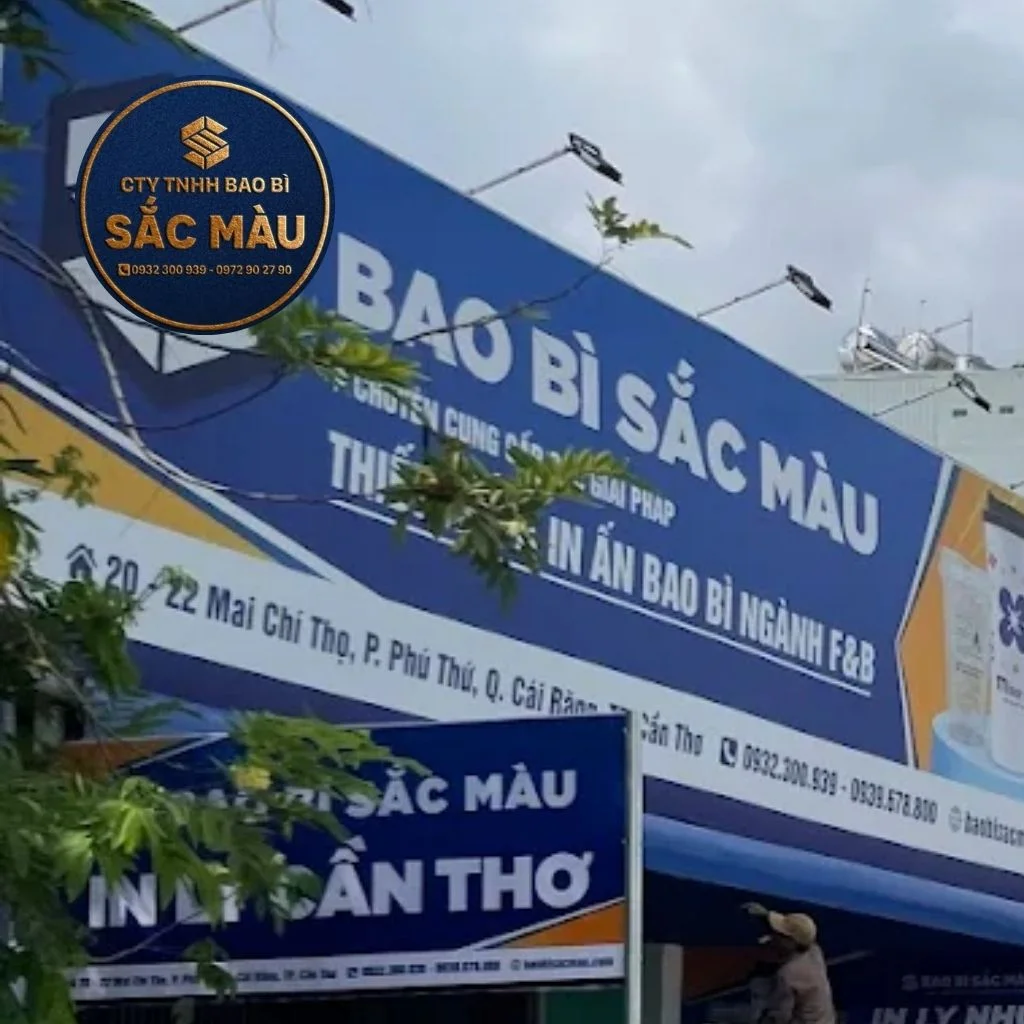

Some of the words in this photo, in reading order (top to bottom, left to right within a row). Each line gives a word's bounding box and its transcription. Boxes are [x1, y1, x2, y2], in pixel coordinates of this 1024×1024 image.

[337, 233, 514, 384] BAO
[532, 326, 600, 431] BÌ
[615, 358, 747, 494] SẮC
[758, 439, 879, 556] MÀU
[444, 406, 501, 457] CUNG
[106, 555, 139, 598] 20
[205, 585, 254, 630] Mai
[310, 615, 355, 666] Thọ,
[363, 631, 380, 667] P.
[388, 639, 430, 679] Phú
[485, 667, 503, 703] Q.
[512, 675, 545, 711] Cái
[547, 516, 584, 575] IN
[589, 519, 635, 594] ẤN
[642, 552, 699, 617] BAO
[705, 574, 734, 630] BÌ
[740, 596, 824, 666] NGÀNH
[829, 628, 876, 684] F&B
[463, 761, 577, 813] MÀU
[88, 873, 158, 928] IN
[434, 851, 595, 913] THƠ
